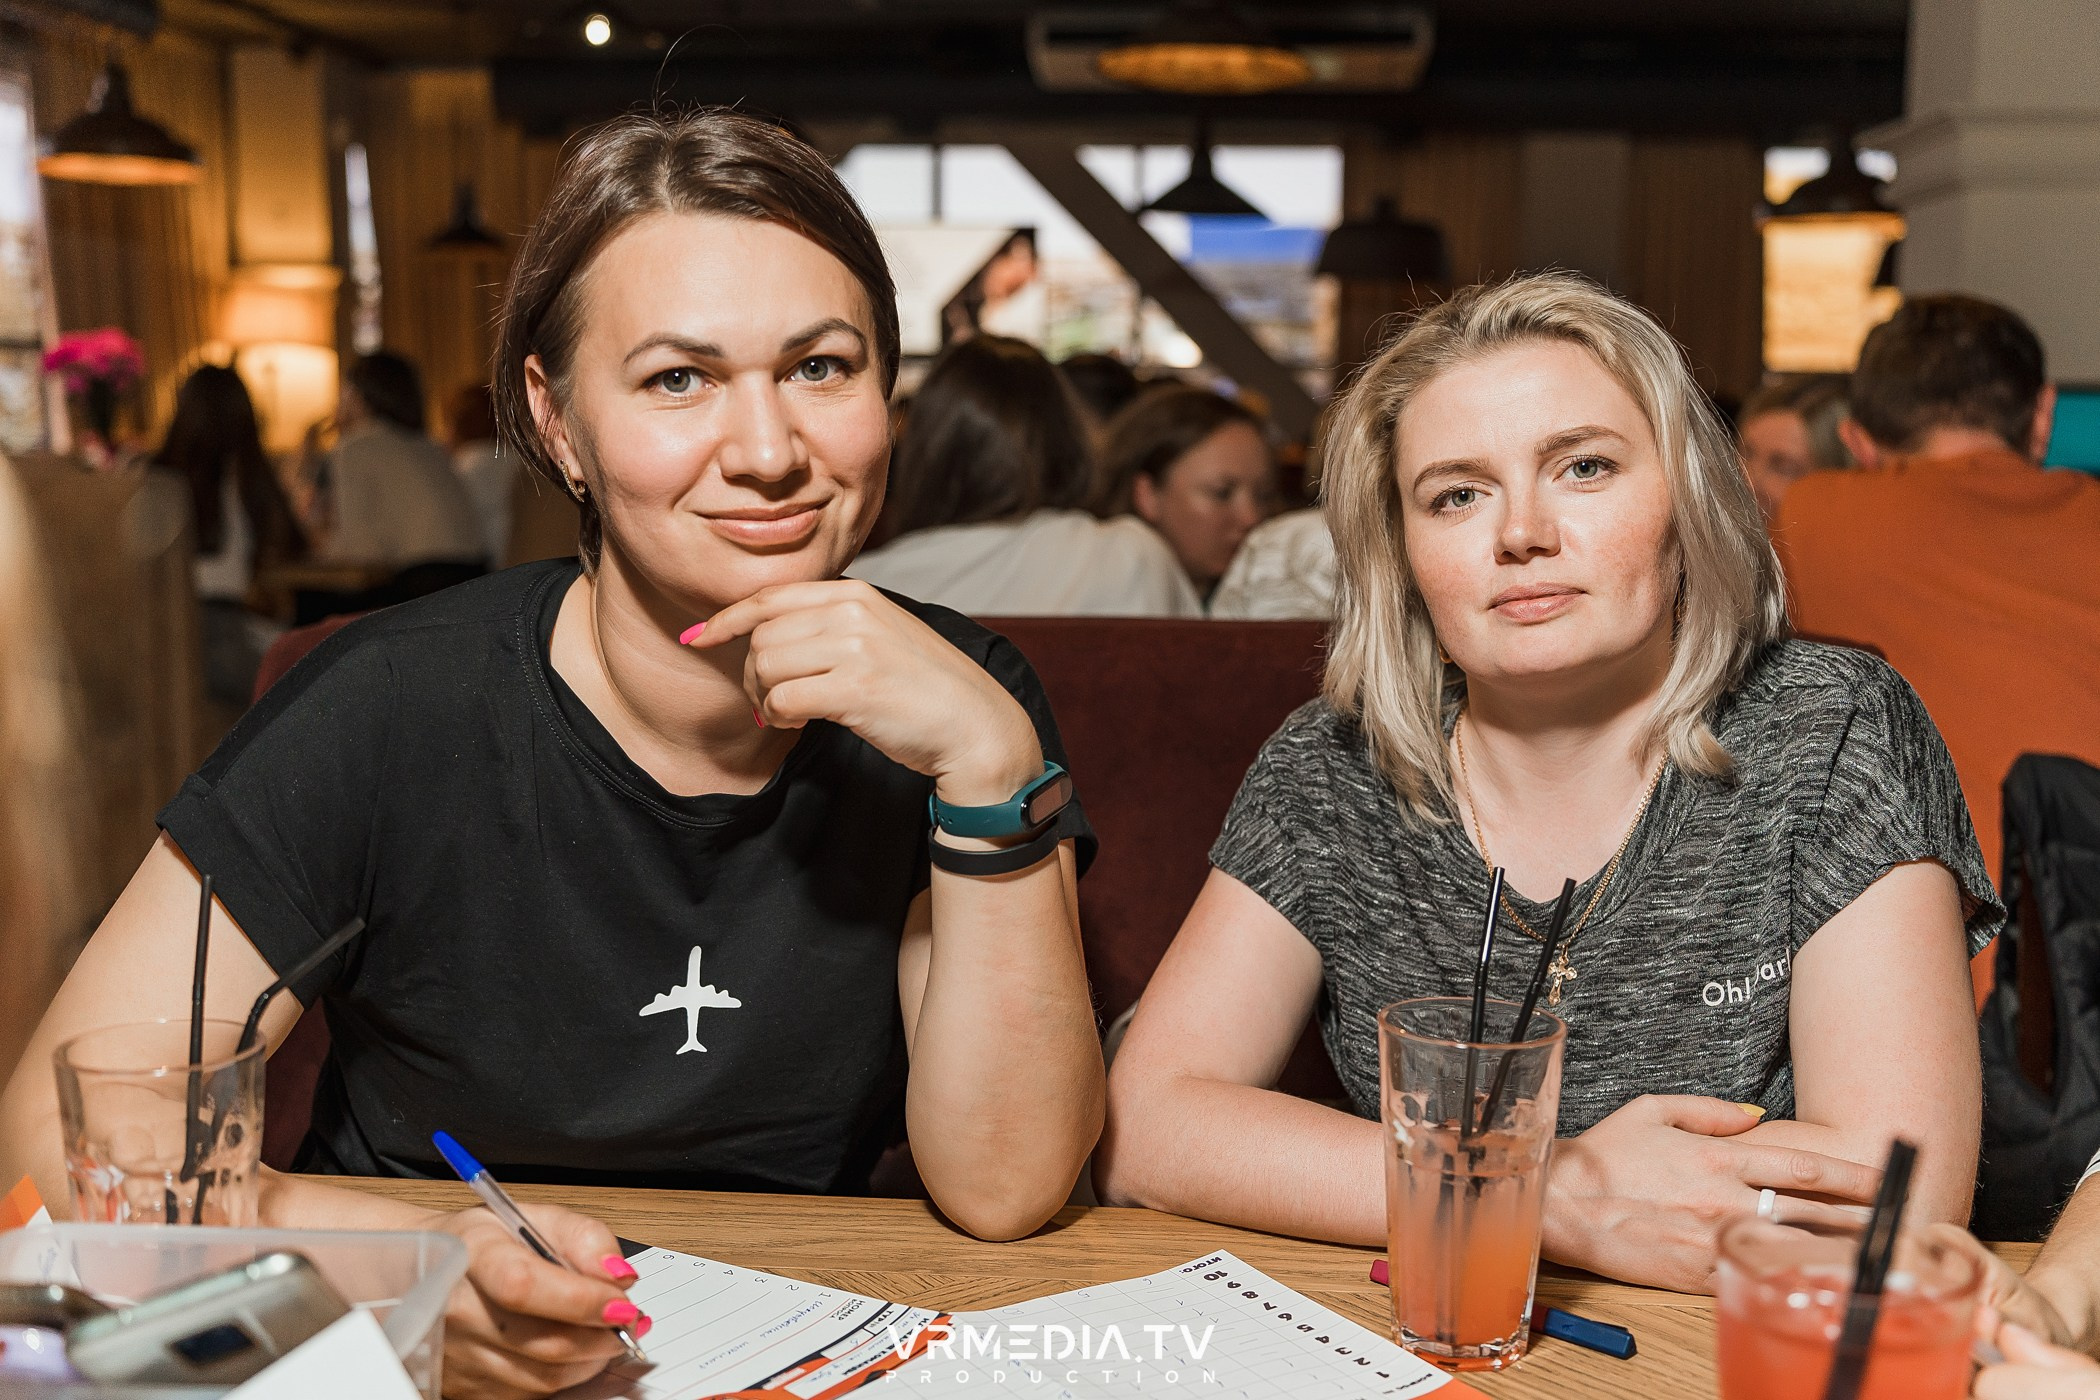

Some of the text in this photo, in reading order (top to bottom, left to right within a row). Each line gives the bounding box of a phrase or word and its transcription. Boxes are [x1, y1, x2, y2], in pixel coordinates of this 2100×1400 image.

[1179, 1256, 1222, 1274] ИТОГО:
[722, 1269, 734, 1277] 4
[1203, 1270, 1229, 1281] 10
[754, 1276, 768, 1285] 3
[1227, 1280, 1242, 1289] 9
[818, 1291, 832, 1299] 1
[1241, 1290, 1259, 1299] 8
[838, 1299, 866, 1321] НОМЕР
[1263, 1301, 1278, 1311] 7
[1277, 1312, 1292, 1322] 6
[1297, 1323, 1315, 1333] 5
[1315, 1335, 1329, 1344] 4
[1335, 1346, 1352, 1356] 3
[1353, 1357, 1371, 1366] 2
[1375, 1371, 1390, 1379] 1
